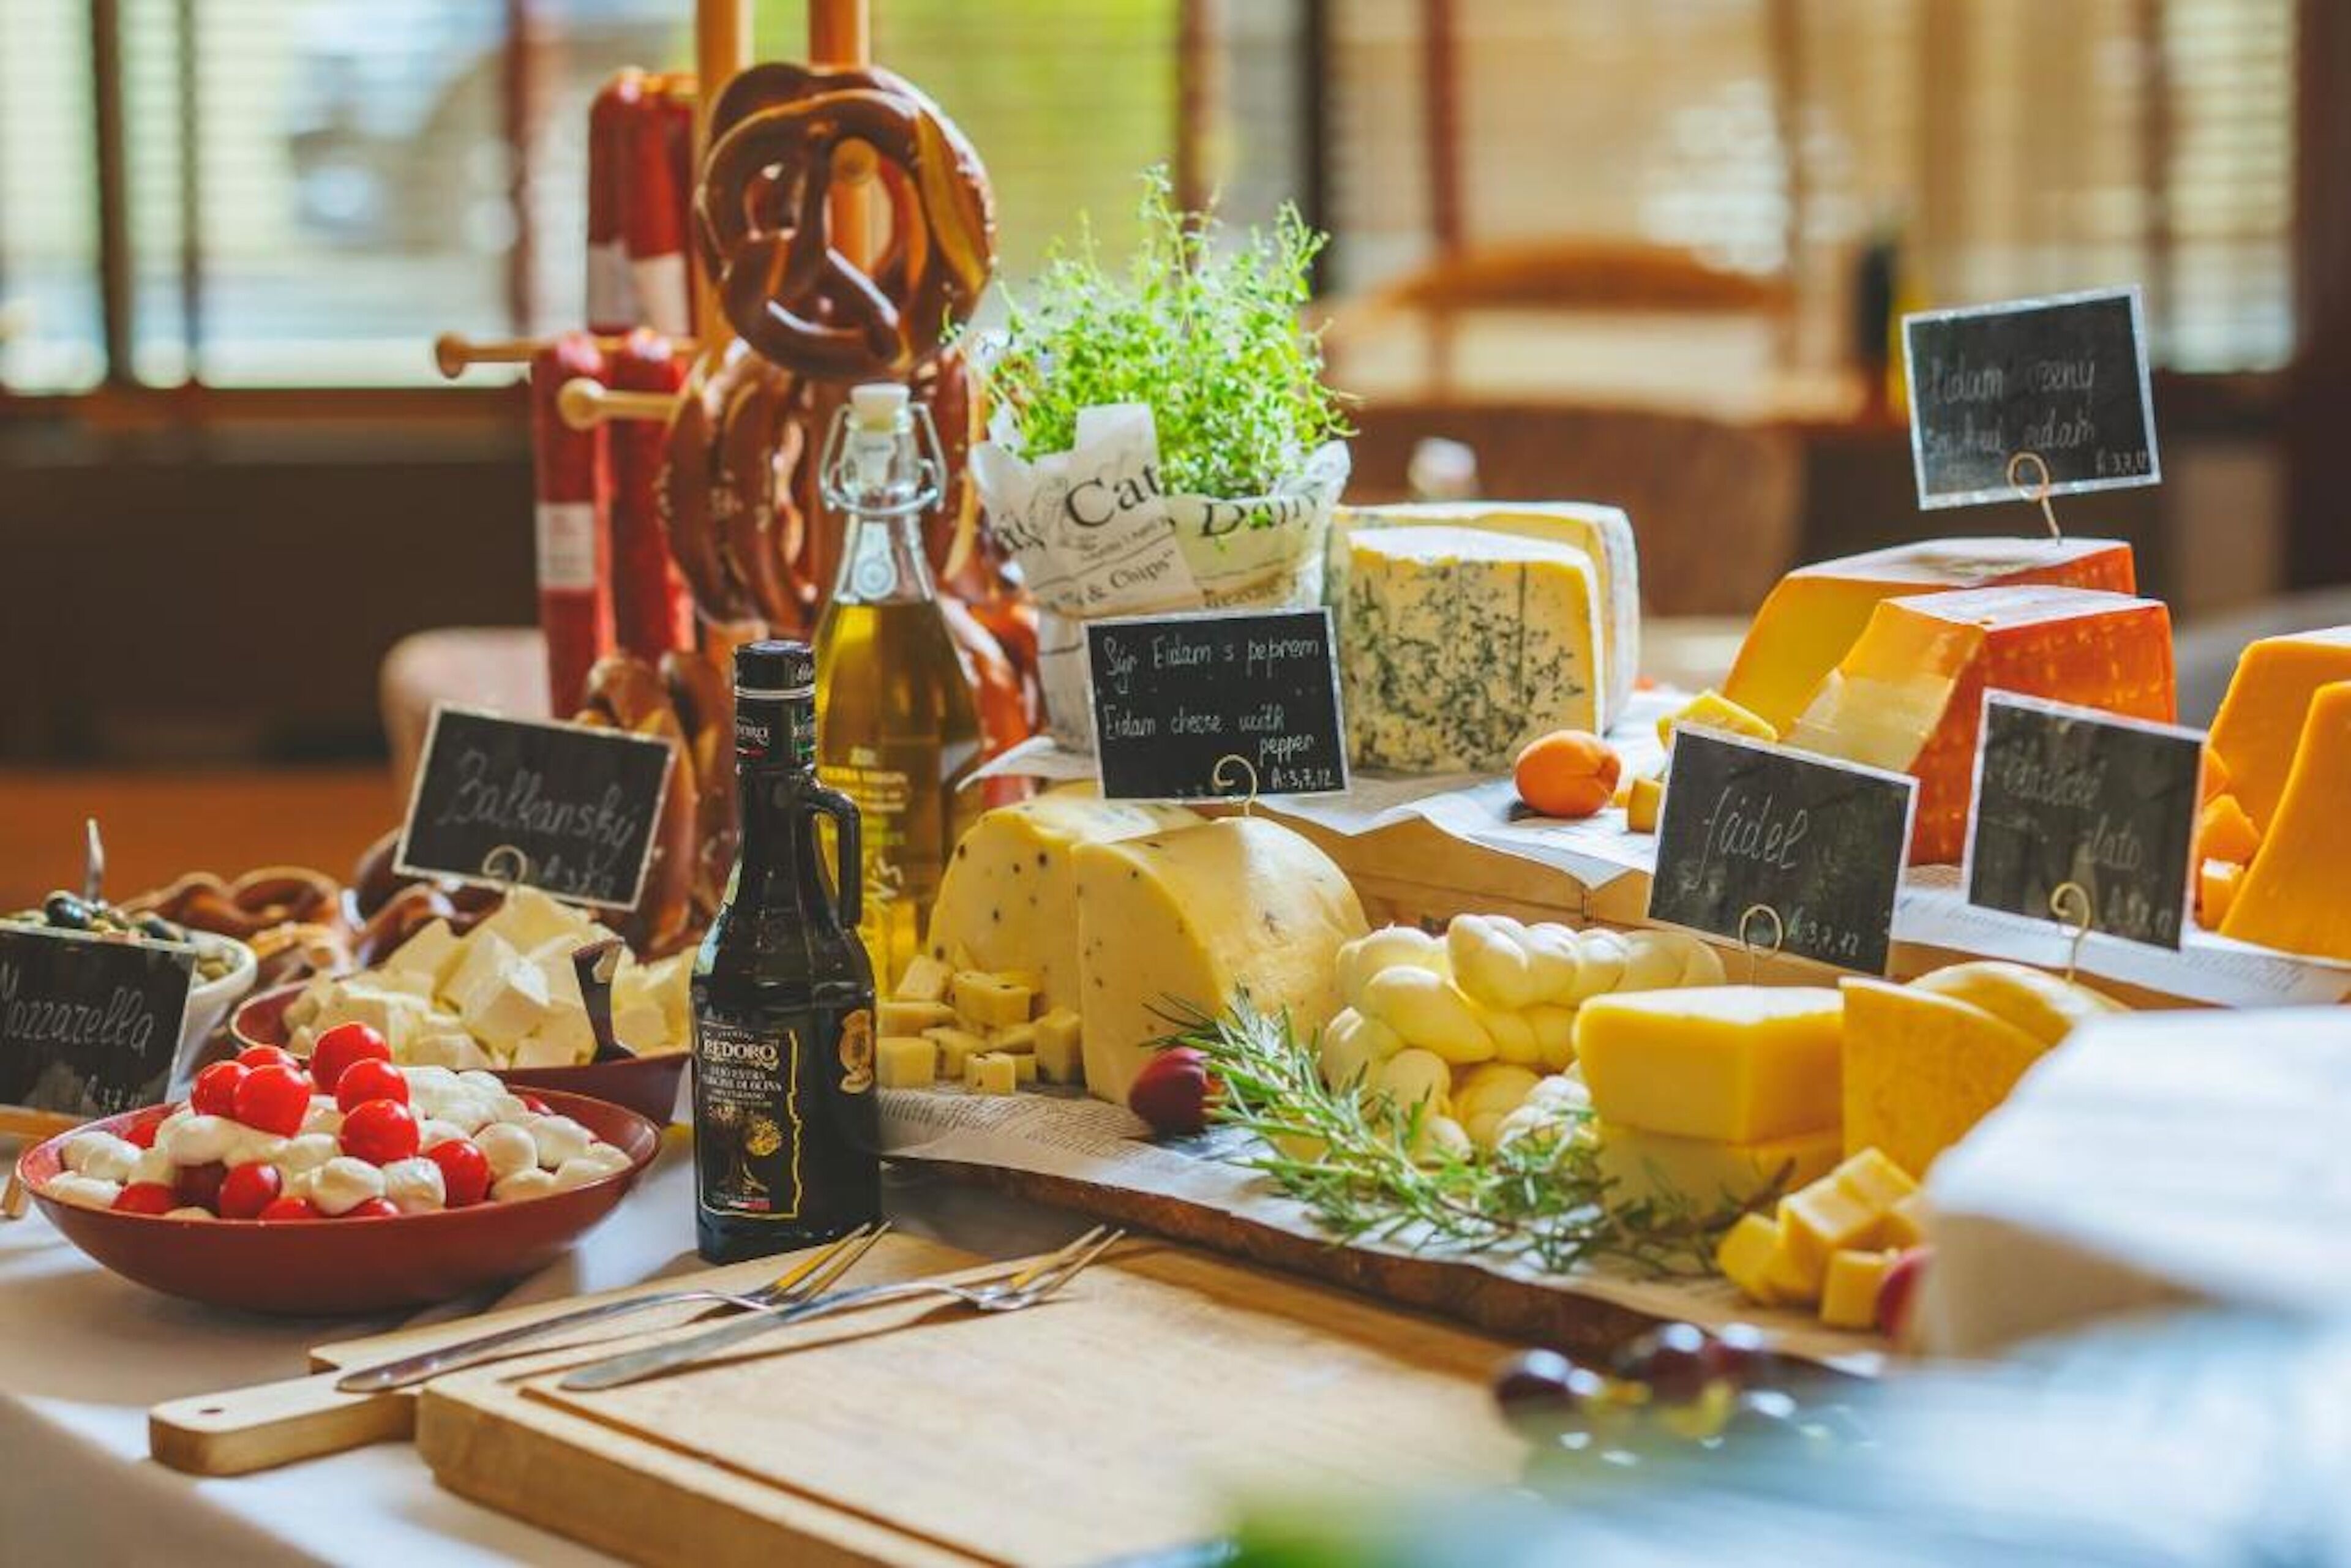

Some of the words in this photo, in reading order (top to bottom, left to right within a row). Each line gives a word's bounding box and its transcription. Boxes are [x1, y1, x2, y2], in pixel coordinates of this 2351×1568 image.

[1152, 632, 1212, 669] Eidam
[1223, 643, 1234, 662] s
[1103, 704, 1157, 740] Eidam
[1169, 705, 1223, 735] cheese
[1238, 703, 1284, 731] with
[1259, 733, 1315, 768] pepper
[703, 1039, 778, 1062] REDORO
